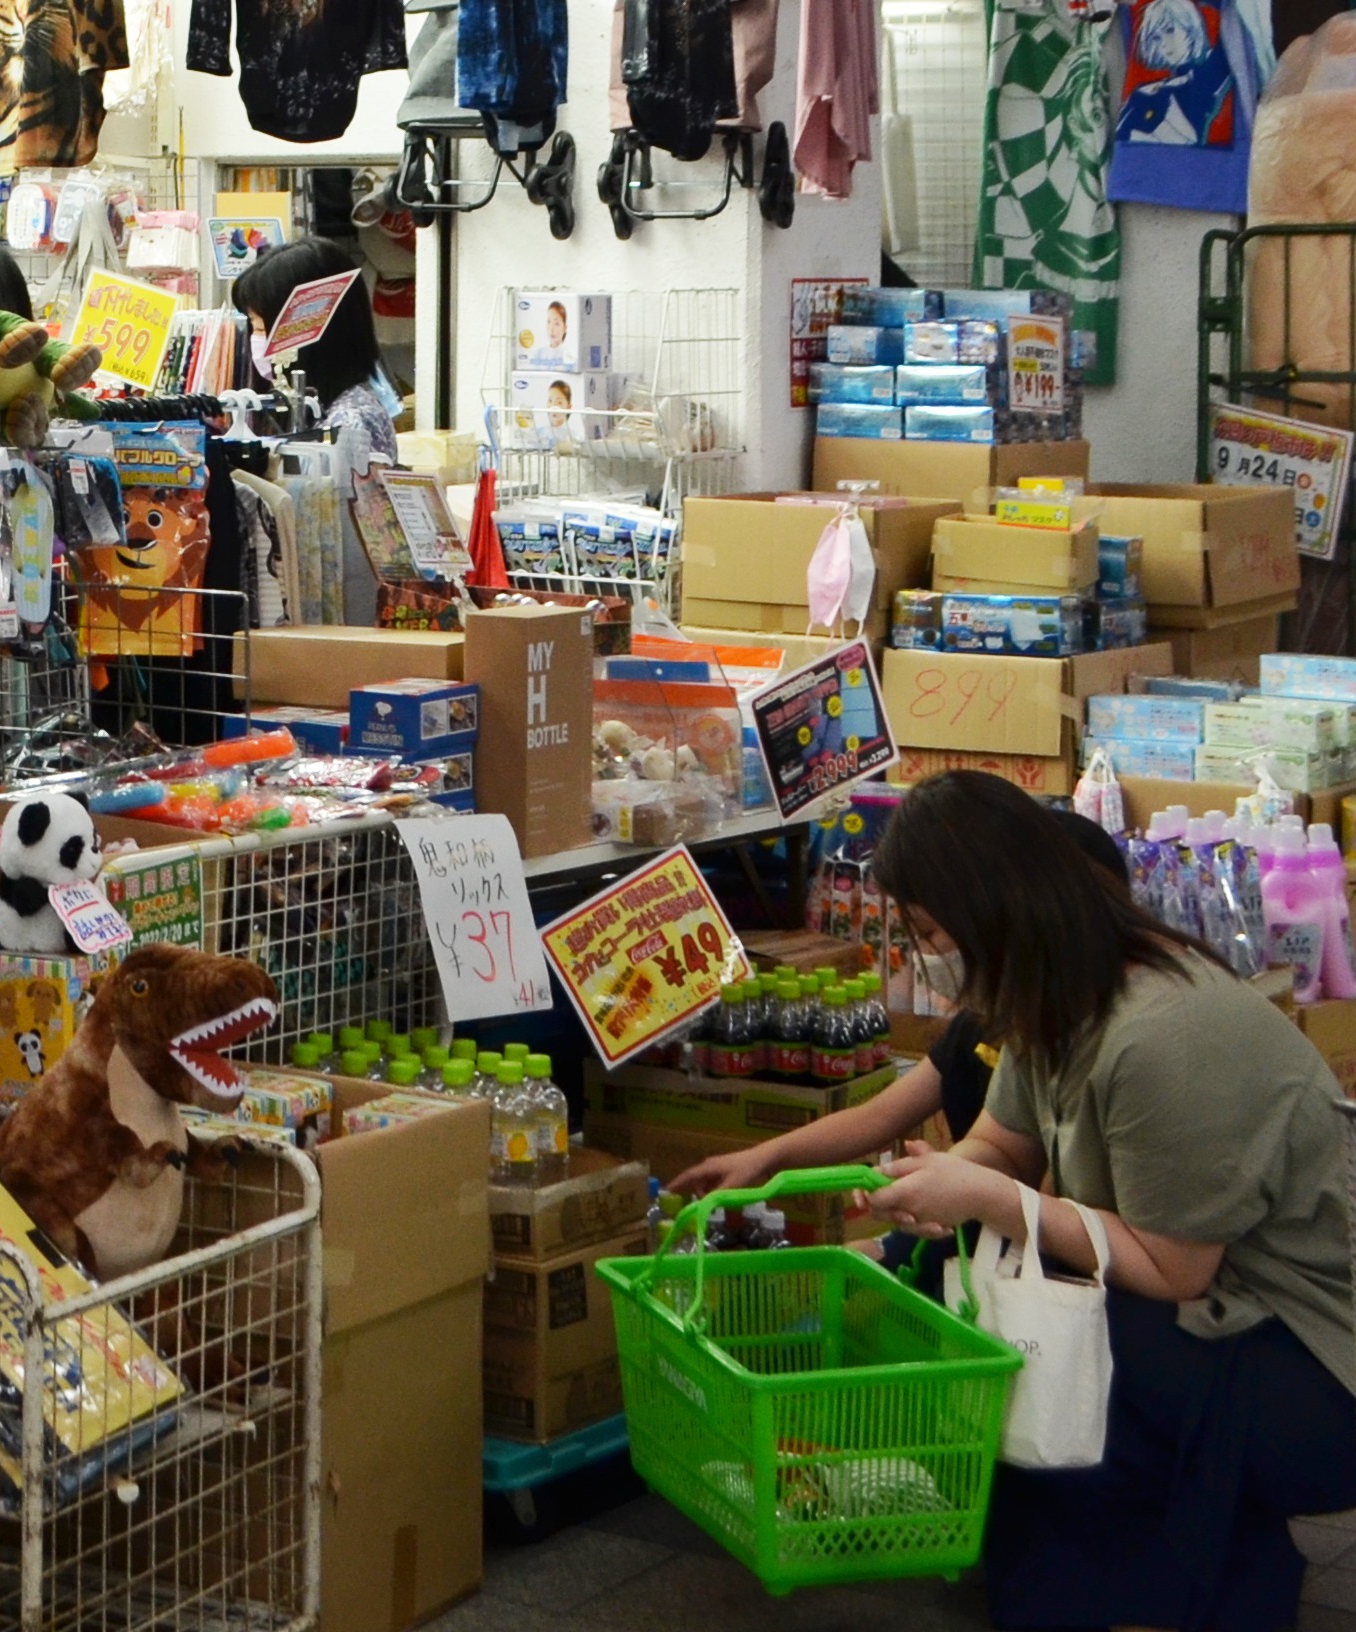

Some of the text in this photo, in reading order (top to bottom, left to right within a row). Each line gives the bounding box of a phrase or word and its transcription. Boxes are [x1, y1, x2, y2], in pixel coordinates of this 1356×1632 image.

[83, 317, 151, 366] ¥599
[528, 641, 555, 672] MY
[527, 675, 548, 725] H
[909, 668, 1018, 726] 899
[527, 722, 569, 750] BOTTLE
[651, 920, 724, 988] ¥49
